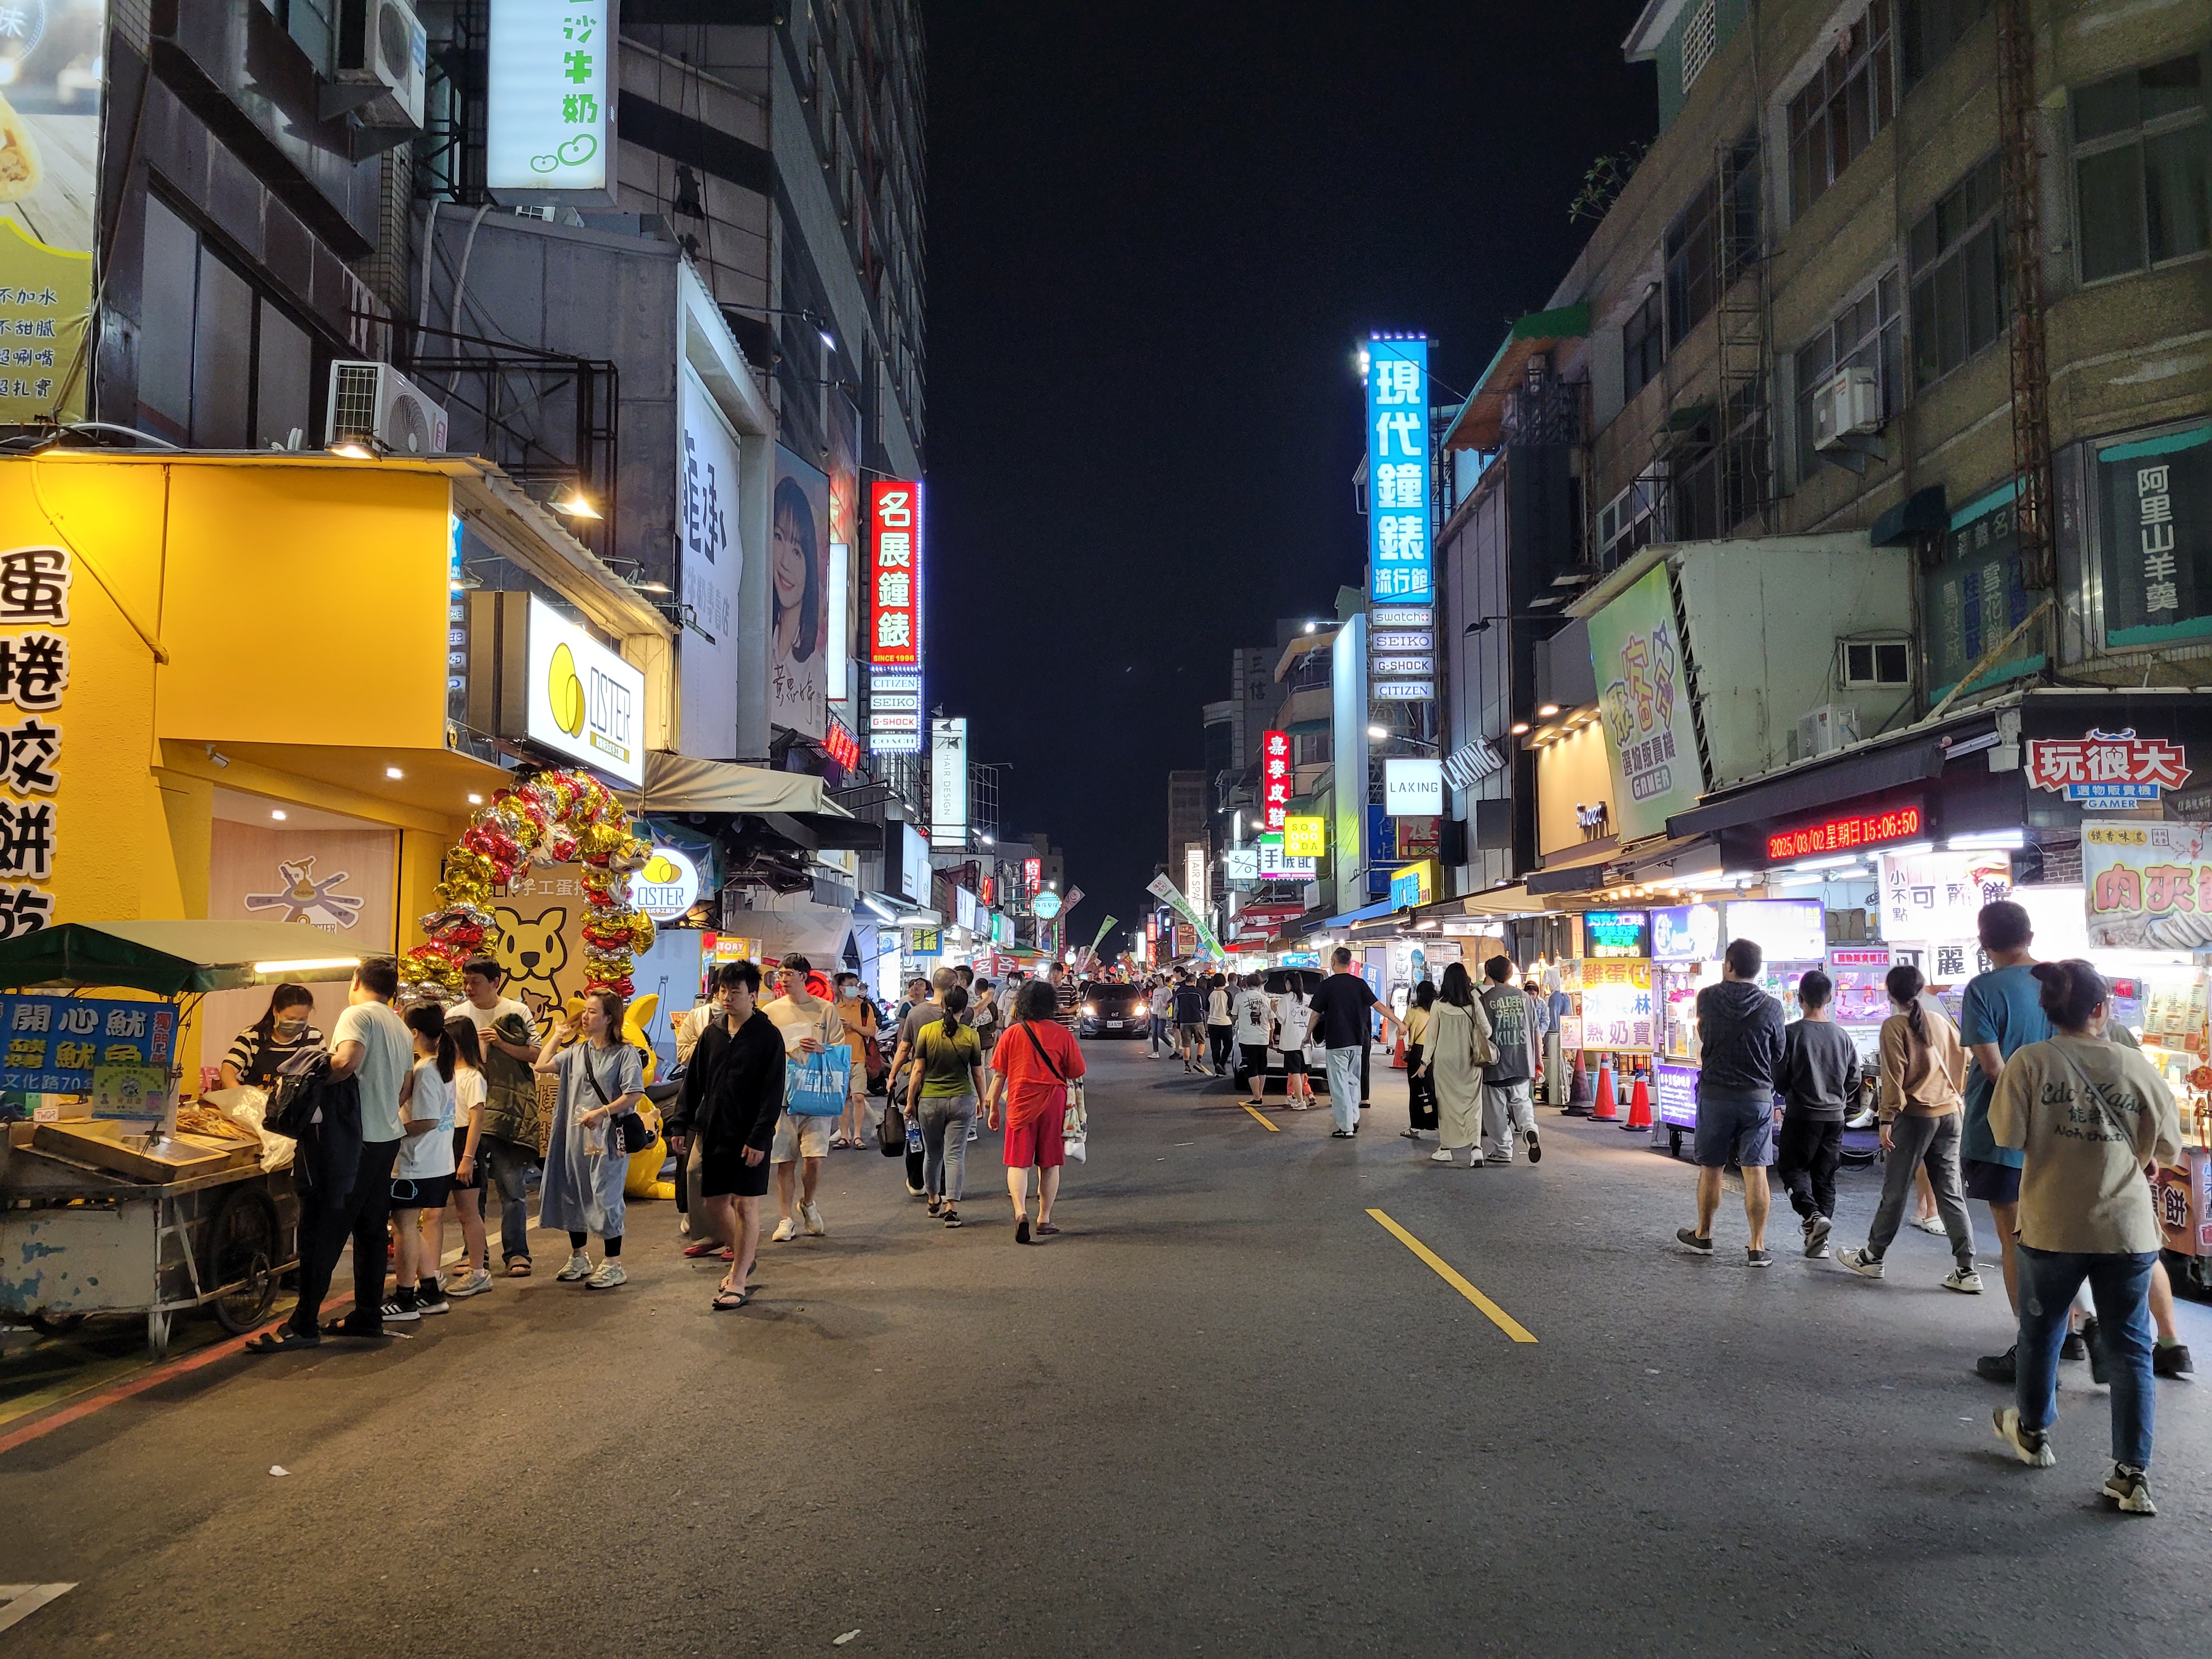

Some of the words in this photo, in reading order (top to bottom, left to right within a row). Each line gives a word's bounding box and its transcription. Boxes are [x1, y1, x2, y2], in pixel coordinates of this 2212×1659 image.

[562, 0, 597, 124] 沙牛奶
[1375, 359, 1424, 561] 現代鐘錶
[877, 492, 911, 648] 名展鐘錶
[1375, 567, 1428, 594] 流行館
[1376, 612, 1420, 621] swatch
[1376, 636, 1429, 647] SEIKO
[1378, 661, 1429, 670] G-SHOCK
[873, 678, 915, 689] CITIZEN
[1379, 686, 1428, 696] CITIZEN
[590, 666, 630, 746] OSTER
[873, 697, 915, 708] SEIKO
[873, 718, 915, 726] G-SHOCK
[1438, 736, 1502, 792] LAKING
[1621, 730, 1677, 777] 選物販賣機
[2040, 744, 2179, 782] 玩很大
[1390, 781, 1438, 793] LAKING
[1634, 769, 1670, 798] GAMER
[2076, 785, 2152, 796] 選物販賣機
[943, 781, 951, 816] DESIGN
[2088, 799, 2135, 809] GAMER
[1770, 831, 1824, 858] 2025/03/02
[1863, 811, 1917, 842] 15:06:50
[1192, 862, 1200, 878] AIR
[638, 887, 684, 906] OSTER
[1192, 881, 1200, 912] SPACE
[1890, 870, 1908, 922] 小不點
[1589, 915, 1645, 927] 巧克力口味
[1594, 946, 1640, 957] 香蕉牛奶
[1582, 963, 1651, 985] 雞蛋仔
[1583, 993, 1652, 1015] 冰淋
[10, 1003, 146, 1037] 開心魷
[1495, 1029, 1526, 1046] KILLS
[1587, 1020, 1651, 1046] 熱奶寶
